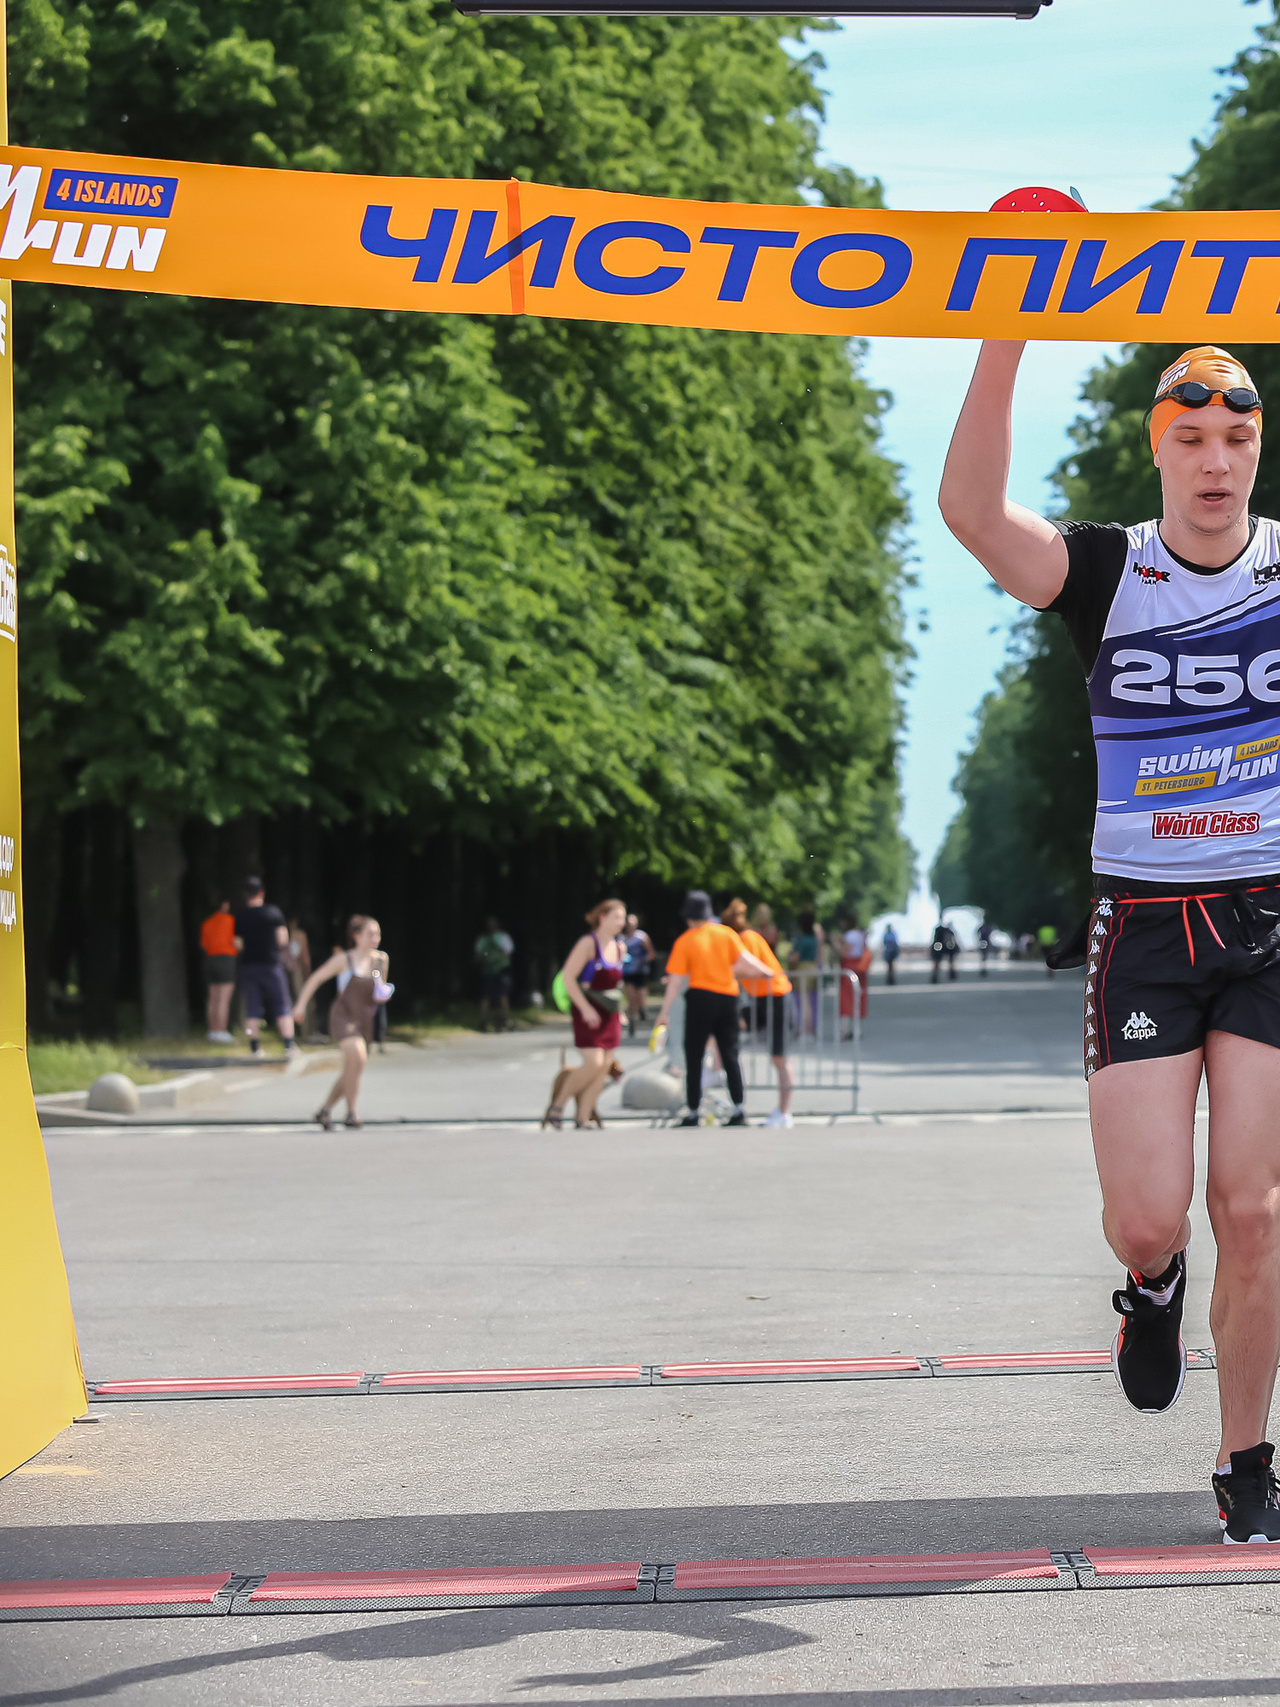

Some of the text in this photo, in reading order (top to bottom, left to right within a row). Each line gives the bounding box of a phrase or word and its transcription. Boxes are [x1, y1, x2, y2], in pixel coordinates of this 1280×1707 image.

[56, 178, 72, 201] 4
[74, 179, 165, 208] ISLANDS
[359, 203, 913, 310] ЧИСТО
[1246, 739, 1278, 755] ISLANDS
[1141, 776, 1205, 791] ST. PETERSBURG
[1156, 813, 1257, 836] World Class
[1124, 1028, 1156, 1040] Kappa
